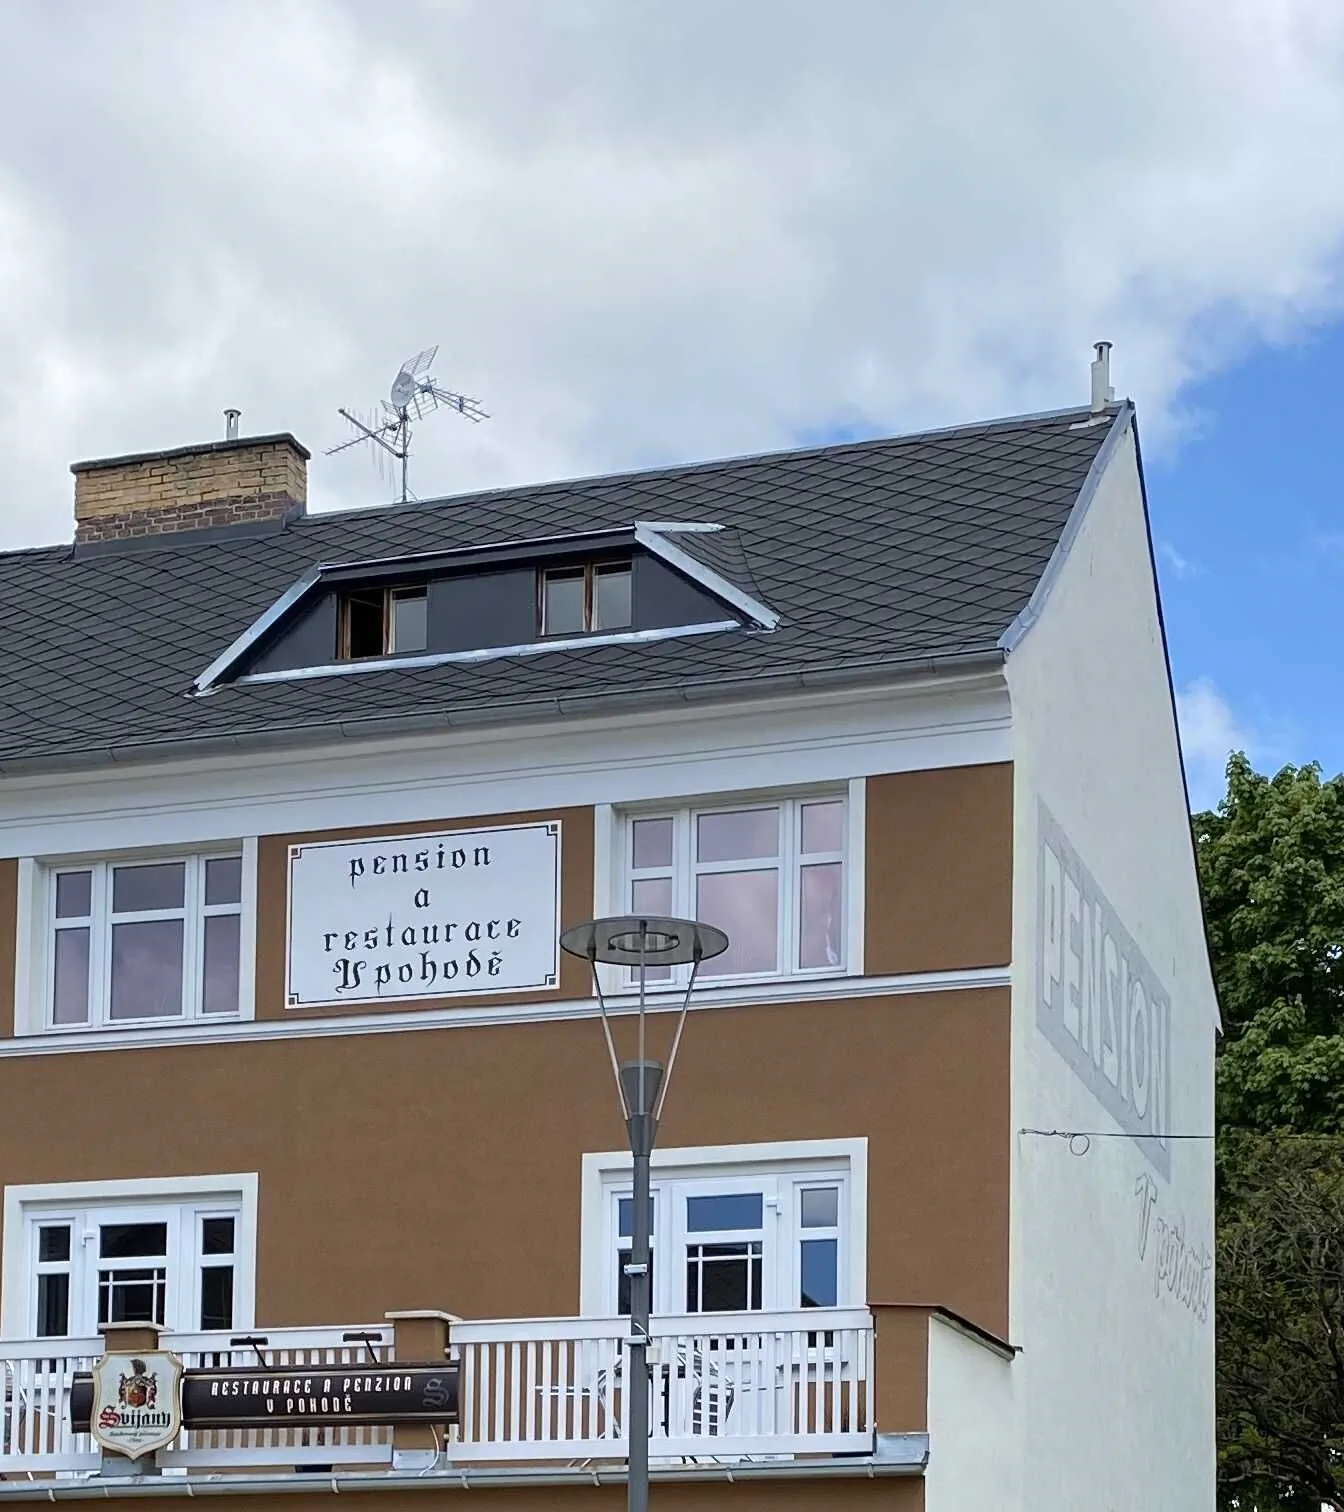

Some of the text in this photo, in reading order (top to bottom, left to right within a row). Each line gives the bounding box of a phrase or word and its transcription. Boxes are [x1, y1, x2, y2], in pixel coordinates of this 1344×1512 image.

[348, 843, 492, 888] pension
[414, 886, 431, 909] a
[322, 912, 523, 953] restaurace
[1043, 839, 1168, 1152] PENSION
[211, 1376, 413, 1396] RESTAURACE A PENZION
[99, 1404, 171, 1428] Svijany
[286, 1394, 353, 1414] POHODĚ
